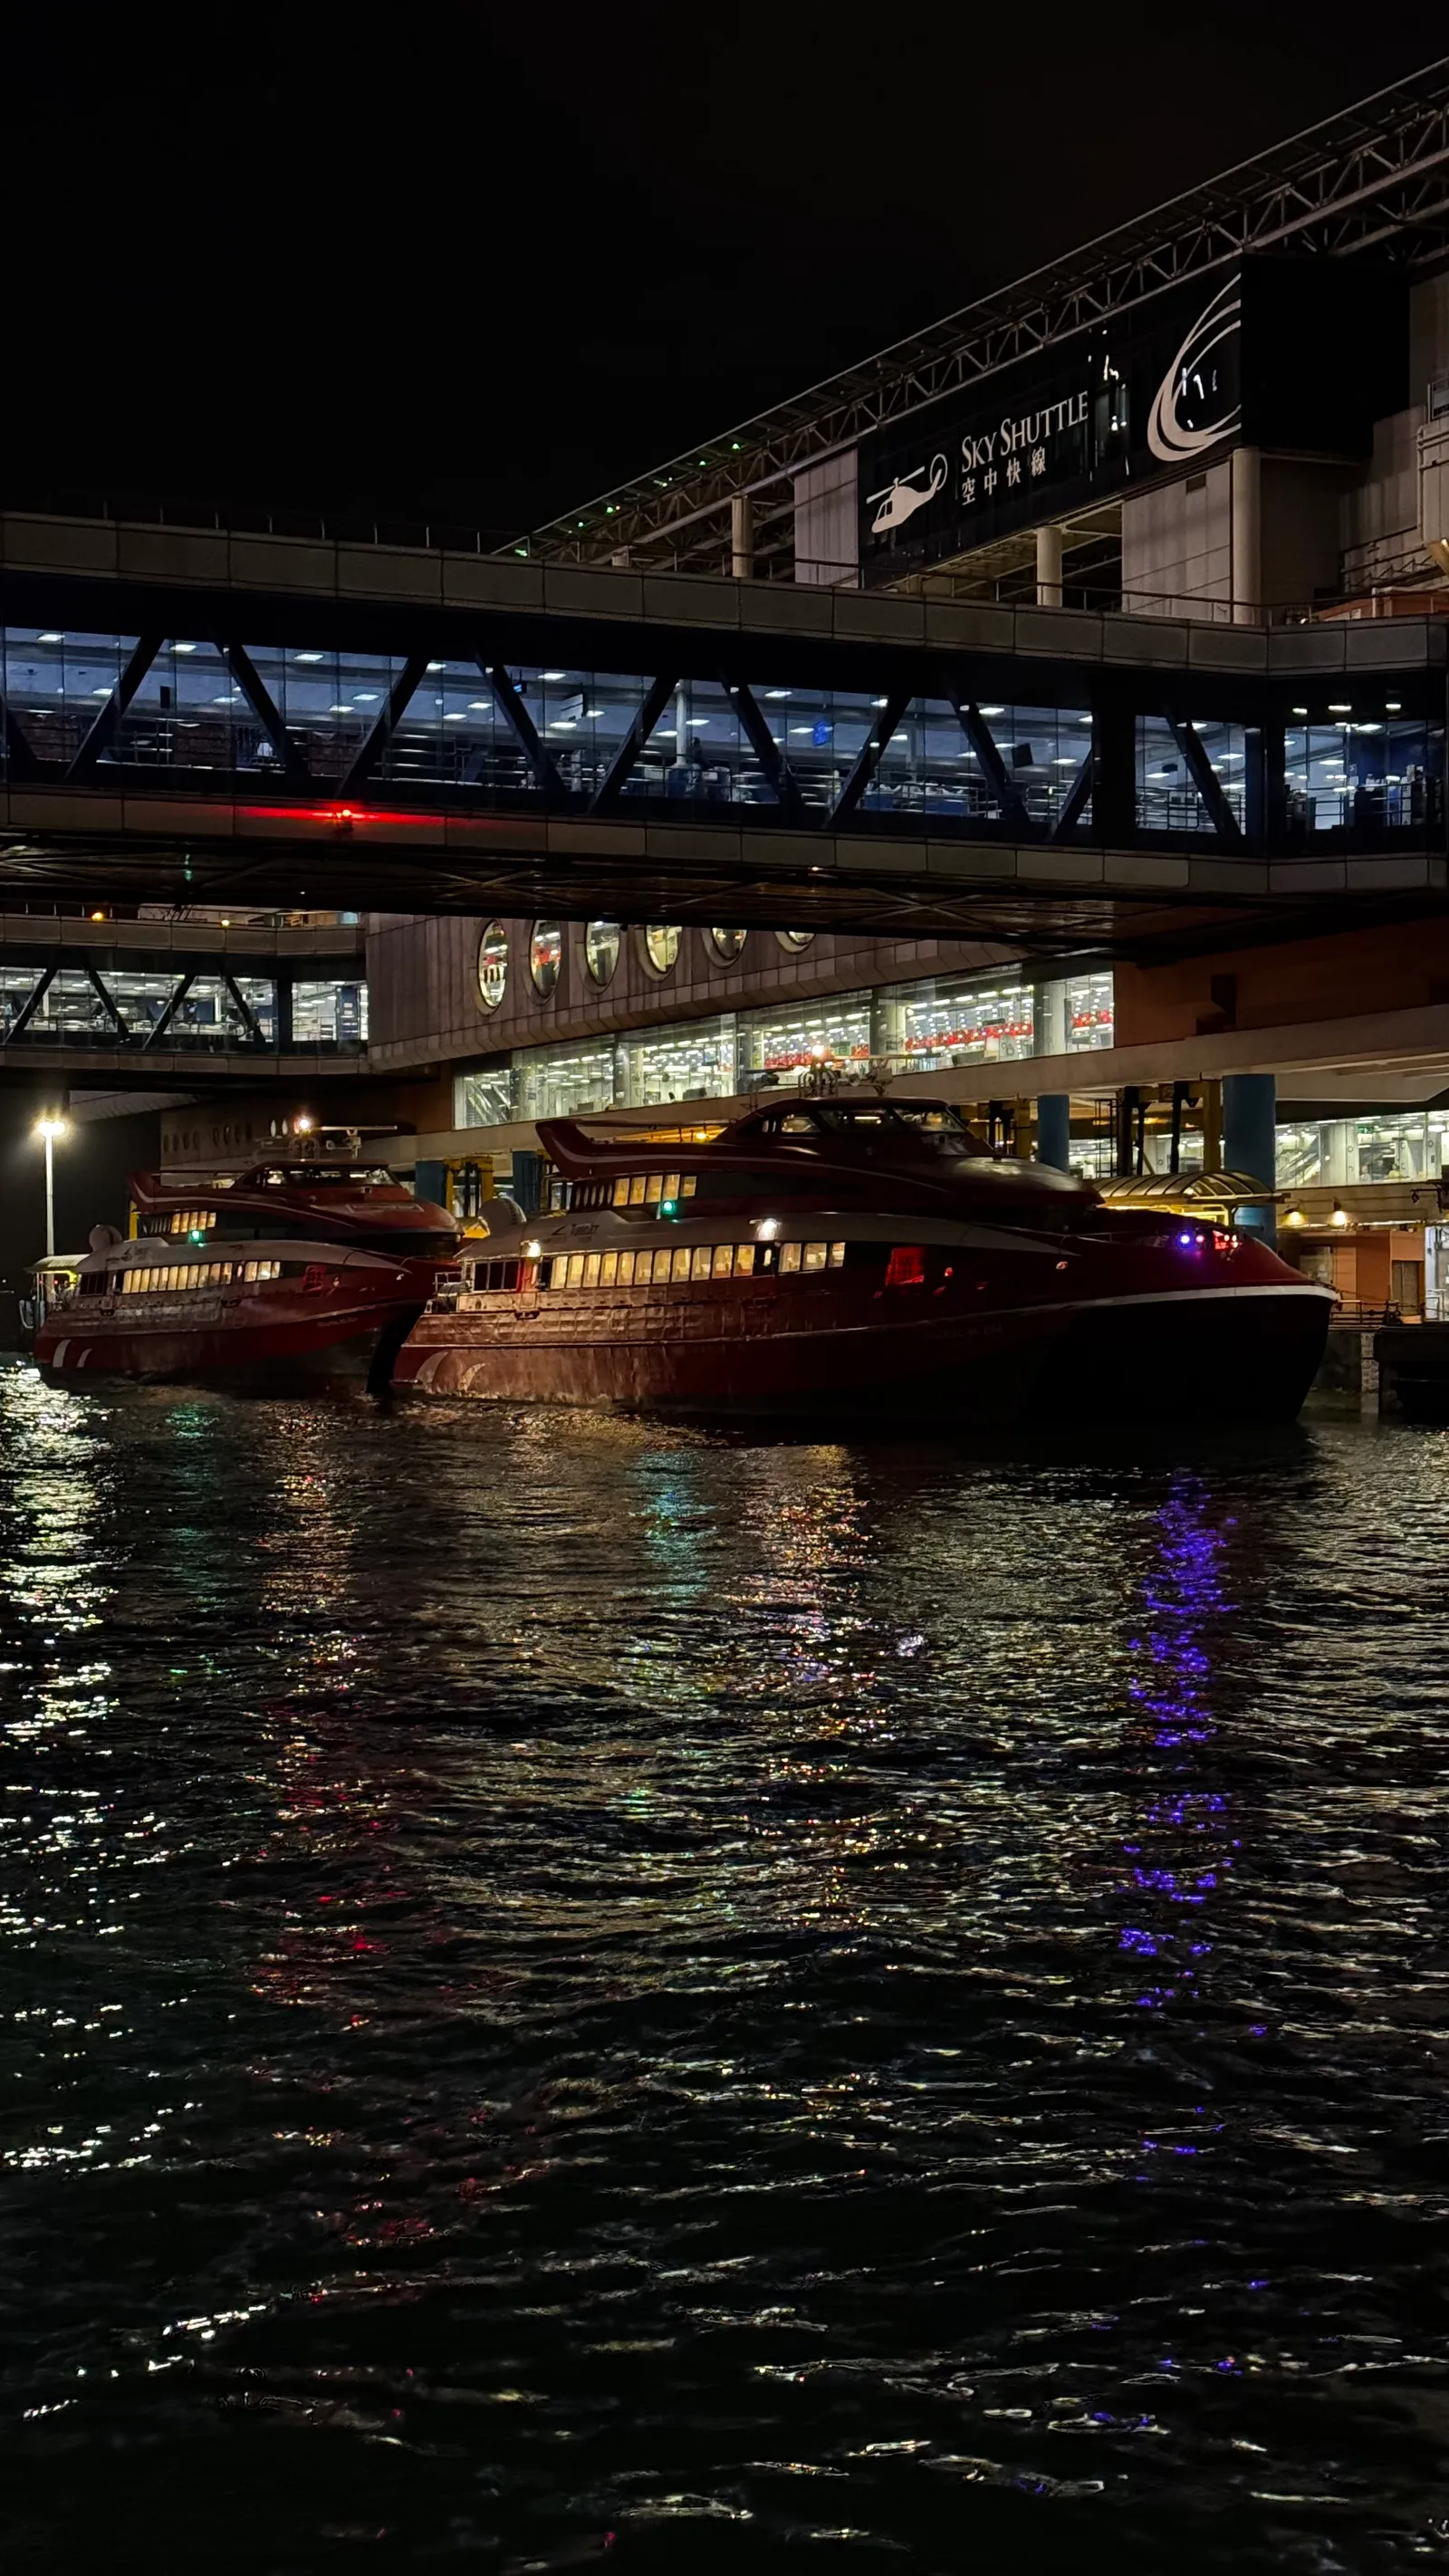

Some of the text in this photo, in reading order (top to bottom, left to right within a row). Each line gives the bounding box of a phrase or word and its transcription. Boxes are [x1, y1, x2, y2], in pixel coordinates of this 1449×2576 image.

[961, 390, 1089, 474] SKY SHUTTLE
[961, 446, 1047, 506] 空中快線
